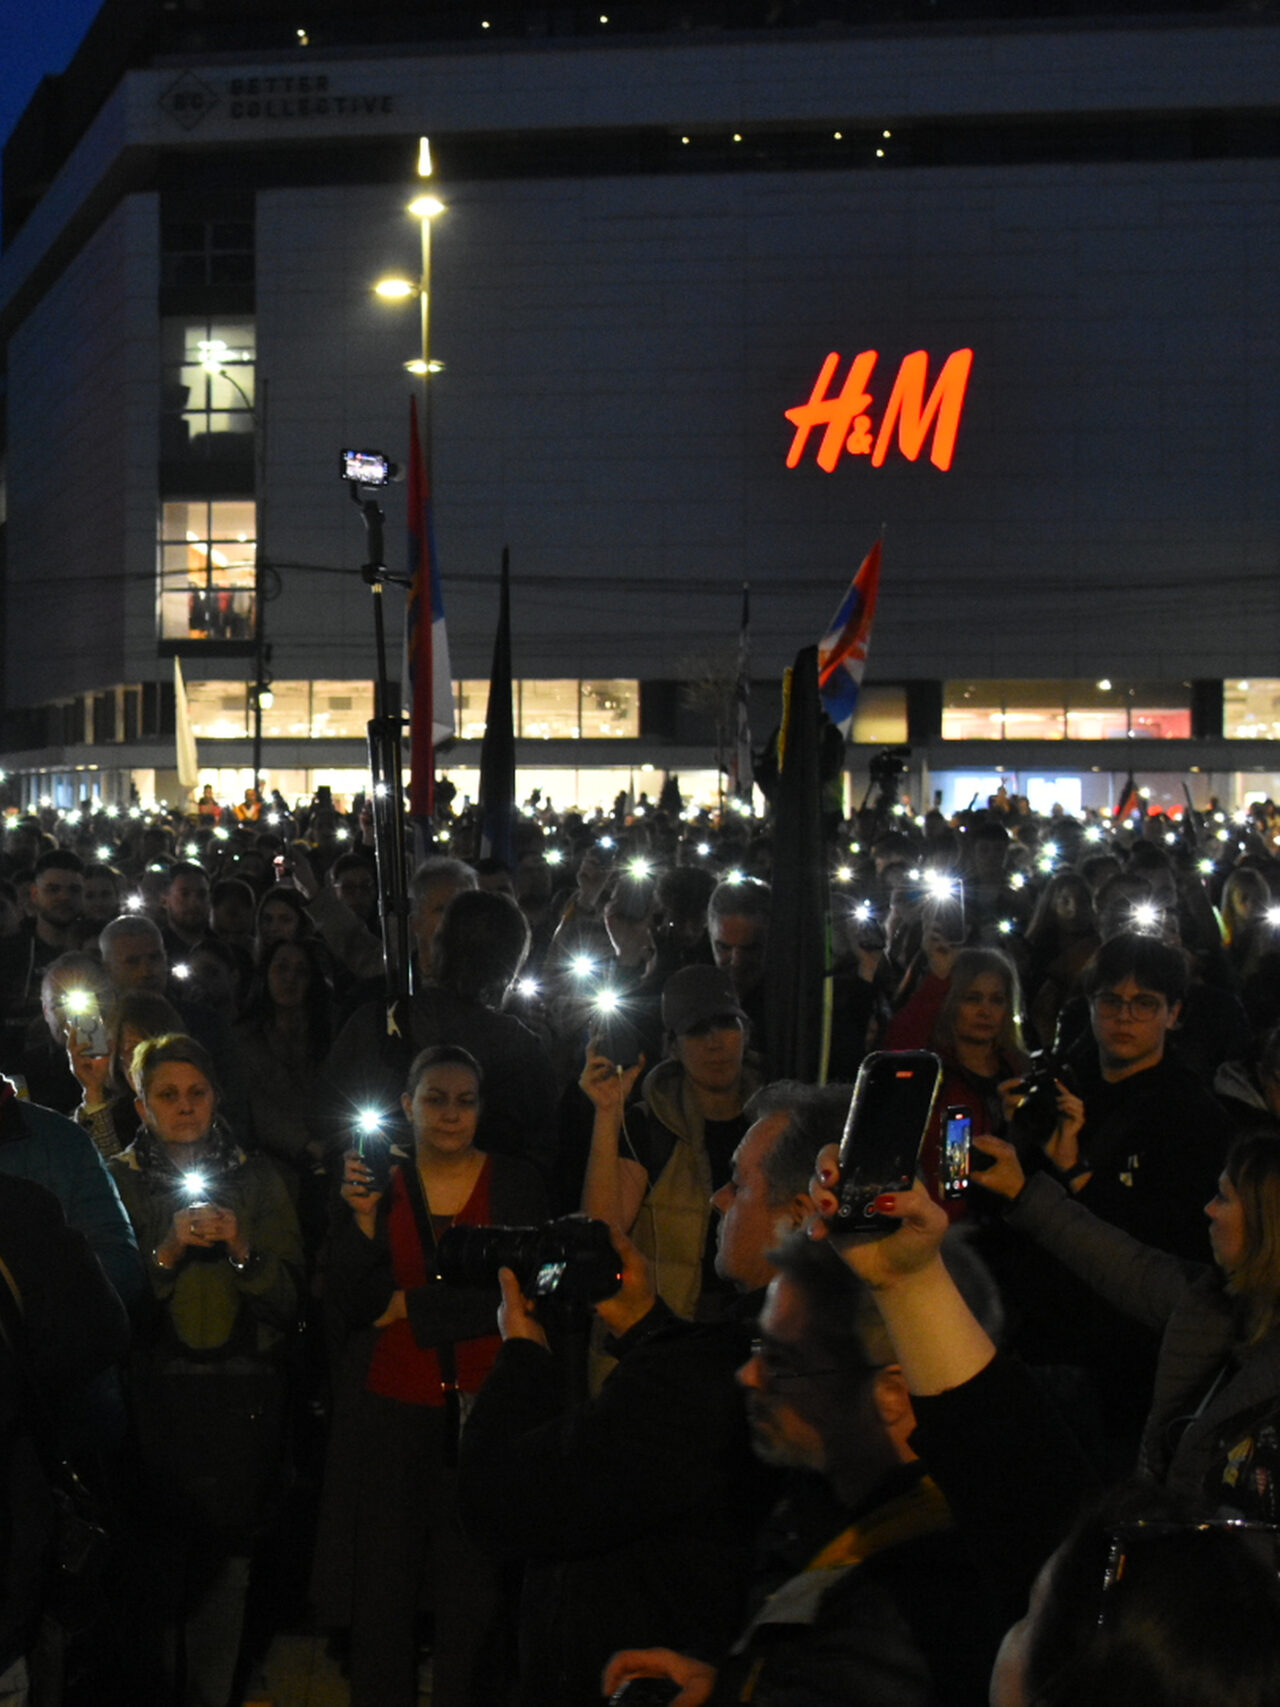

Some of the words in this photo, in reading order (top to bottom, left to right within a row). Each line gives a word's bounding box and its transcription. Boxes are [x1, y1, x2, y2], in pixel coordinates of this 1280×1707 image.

[230, 76, 328, 95] BETTER
[230, 96, 394, 119] COLLECTIVE
[784, 347, 974, 474] H&M
